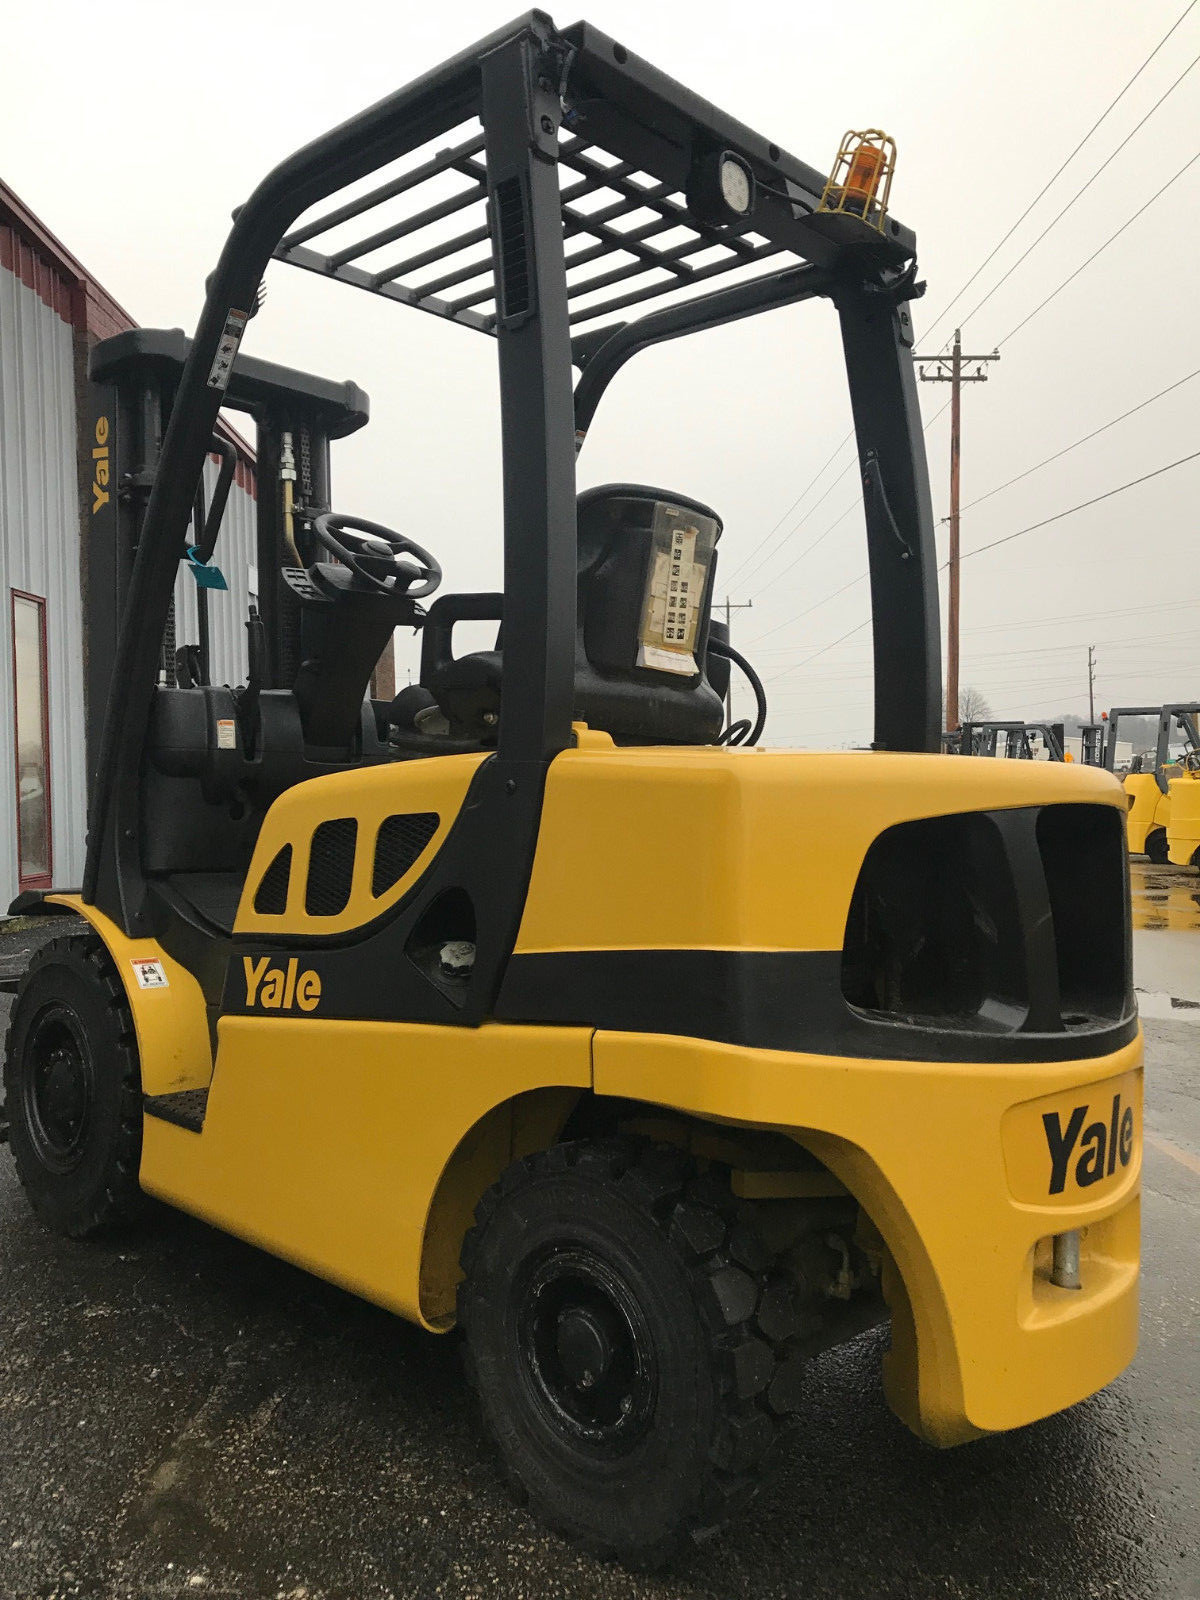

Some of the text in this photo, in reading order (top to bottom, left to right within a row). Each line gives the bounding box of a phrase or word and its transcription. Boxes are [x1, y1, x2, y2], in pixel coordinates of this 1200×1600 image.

[92, 416, 109, 514] Yale
[243, 956, 322, 1012] Yale
[1042, 1094, 1133, 1195] Yale
